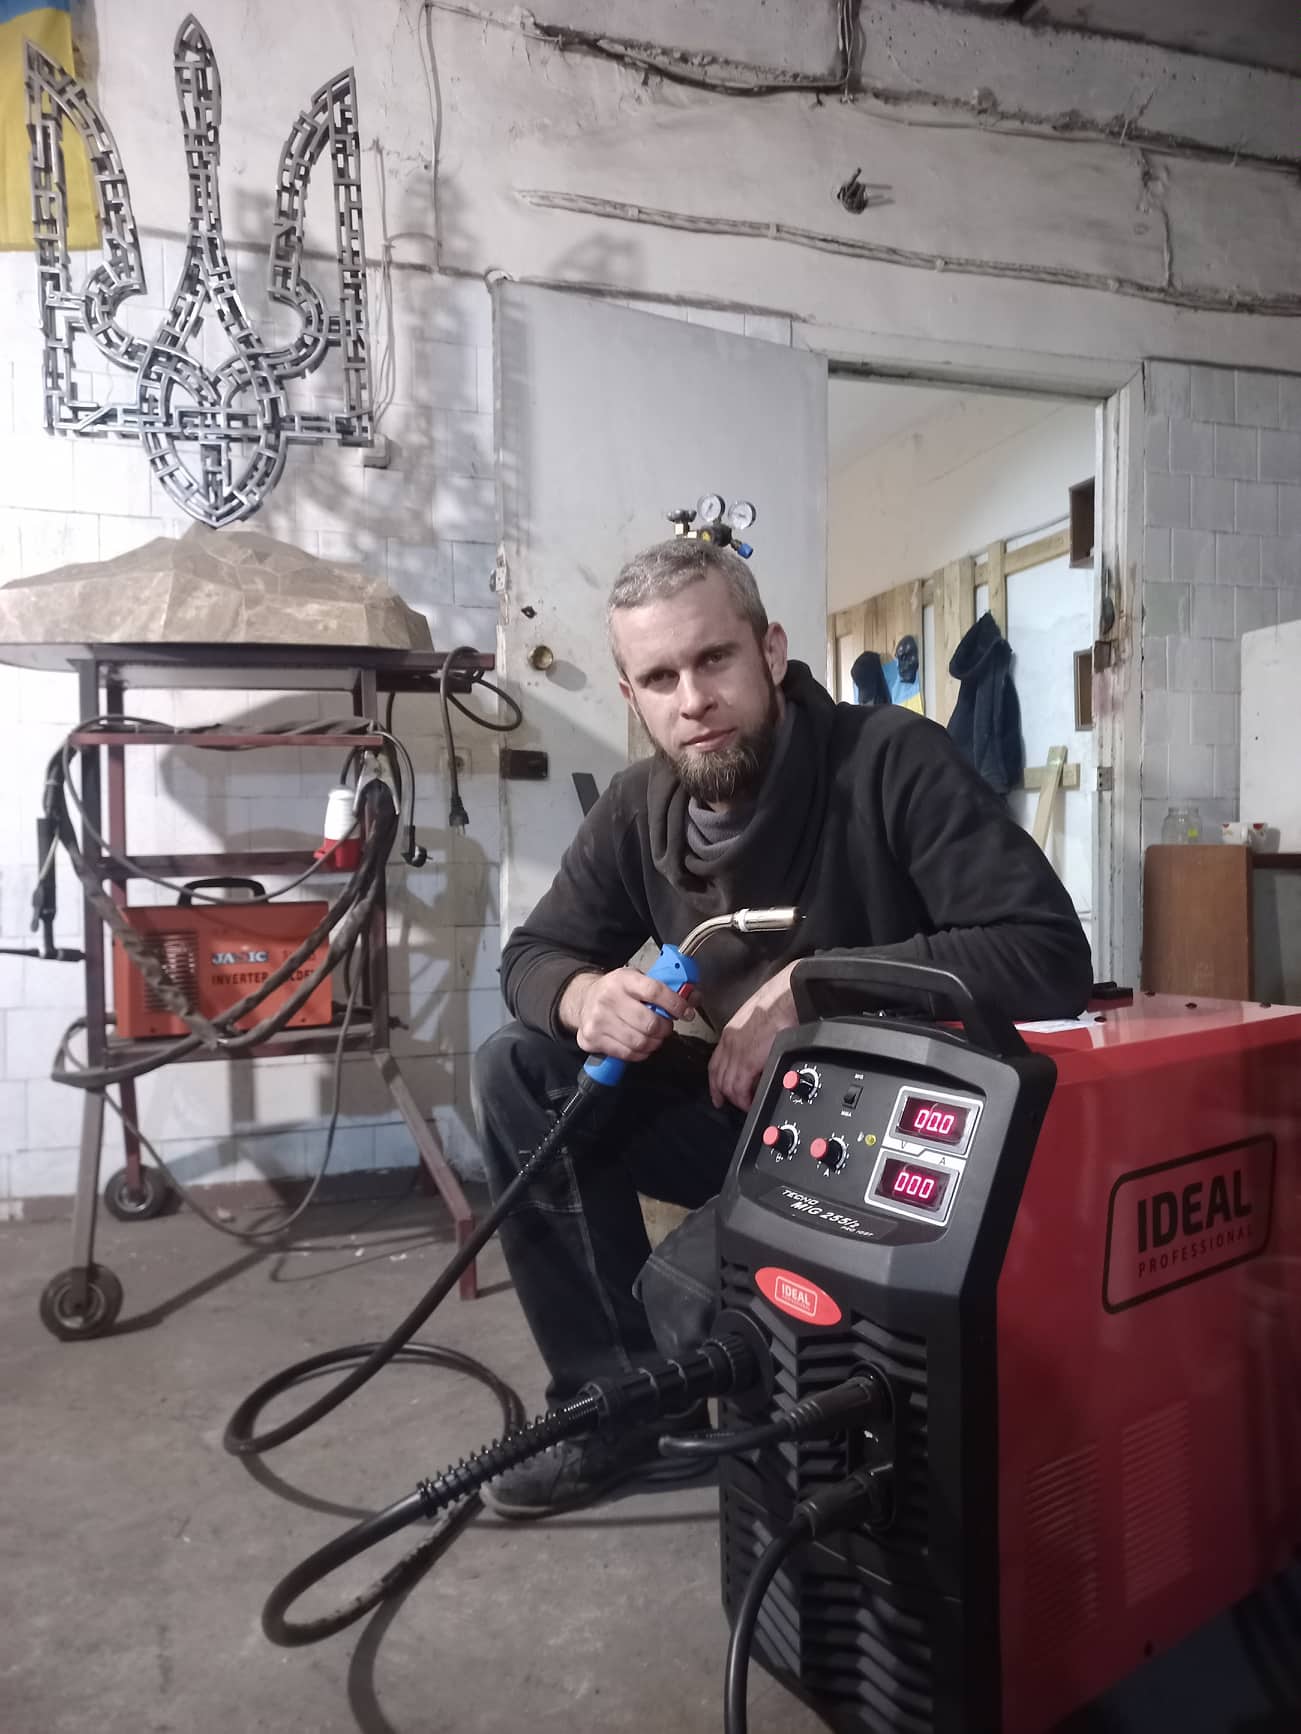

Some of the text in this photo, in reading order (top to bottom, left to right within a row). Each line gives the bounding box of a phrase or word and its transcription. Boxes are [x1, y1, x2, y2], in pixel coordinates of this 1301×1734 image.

[212, 952, 267, 964] JAIC
[939, 1157, 946, 1165] A
[894, 1172, 934, 1199] 000
[782, 1189, 819, 1205] TECNO
[790, 1201, 823, 1215] MIG
[1137, 1169, 1252, 1253] IDEAL
[1138, 1223, 1254, 1279] PROFESSIONAL
[782, 1283, 810, 1304] IDEAL
